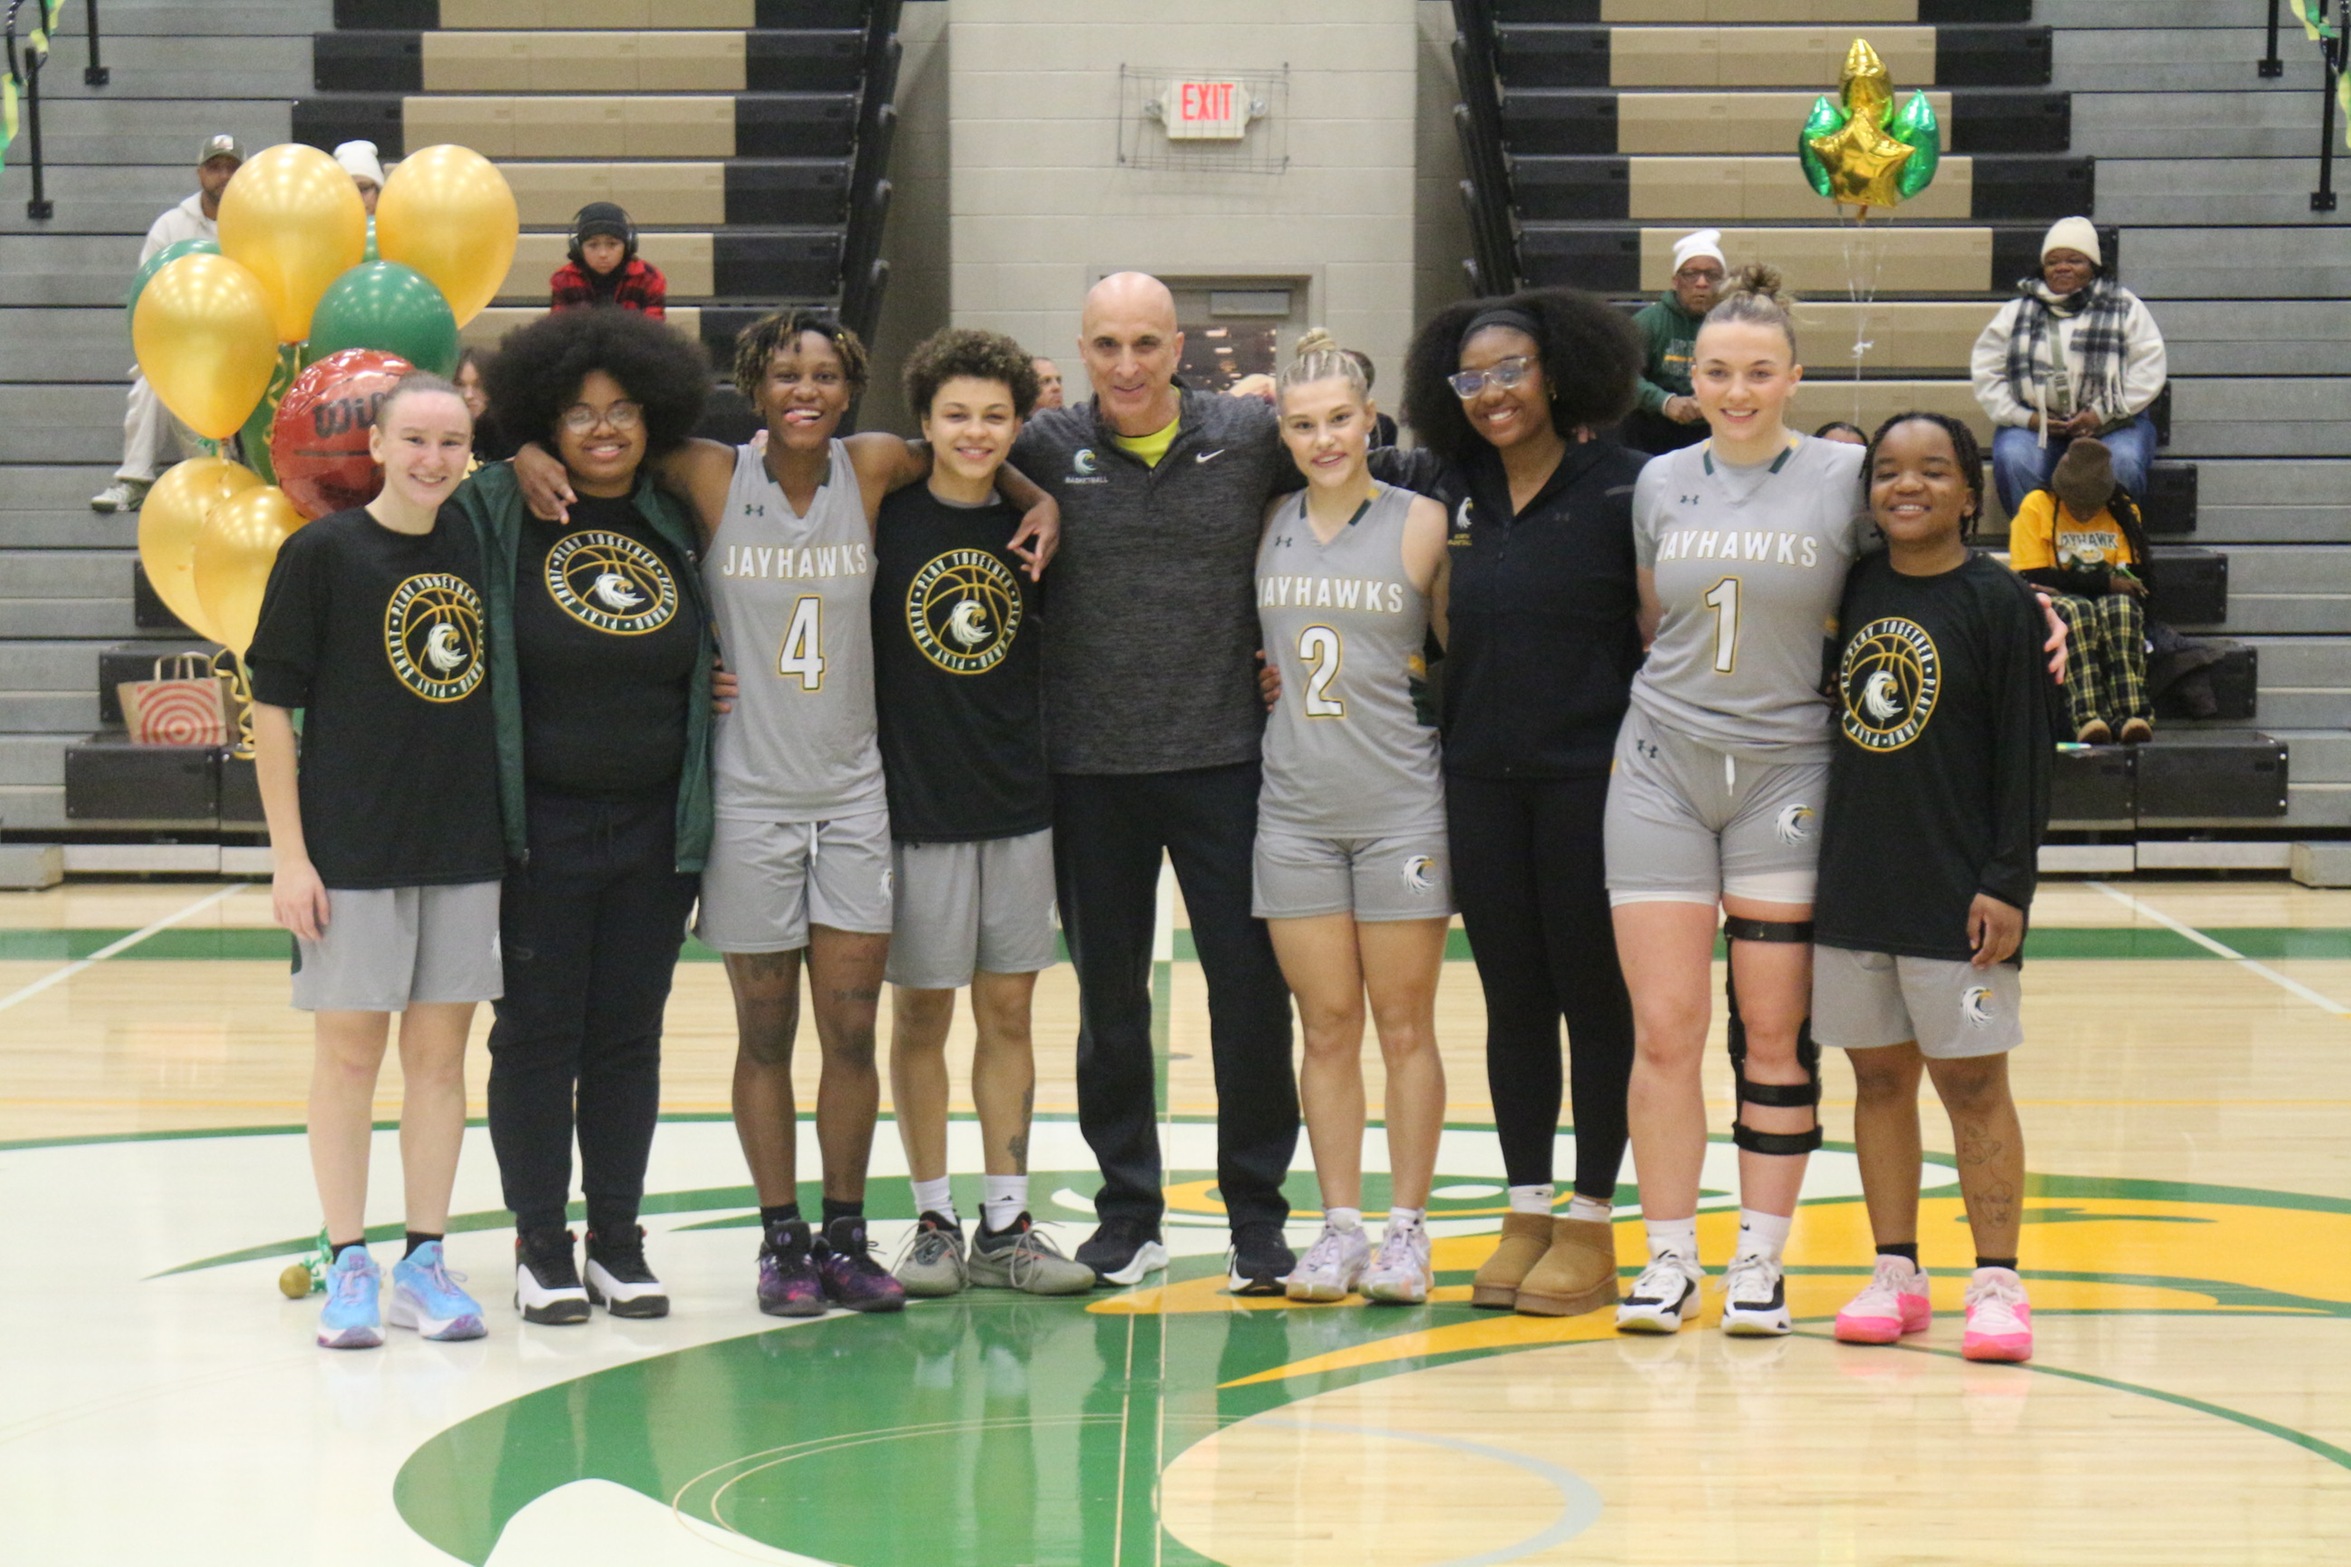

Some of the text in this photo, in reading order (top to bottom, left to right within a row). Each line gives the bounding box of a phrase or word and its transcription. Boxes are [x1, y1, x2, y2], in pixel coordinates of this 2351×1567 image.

[1182, 83, 1234, 121] EXIT
[552, 533, 658, 568] PLAY TOGETHER
[2060, 531, 2119, 549] AYHAWK
[723, 543, 868, 579] JAYHAWKS
[916, 551, 1013, 590] PLAY TOGETHER
[578, 607, 618, 631] PLAY
[1704, 575, 1741, 674] 1
[778, 594, 826, 692] 4
[934, 648, 966, 671] PLAY
[1882, 620, 1935, 664] TOGETHER
[1297, 624, 1347, 718] 2
